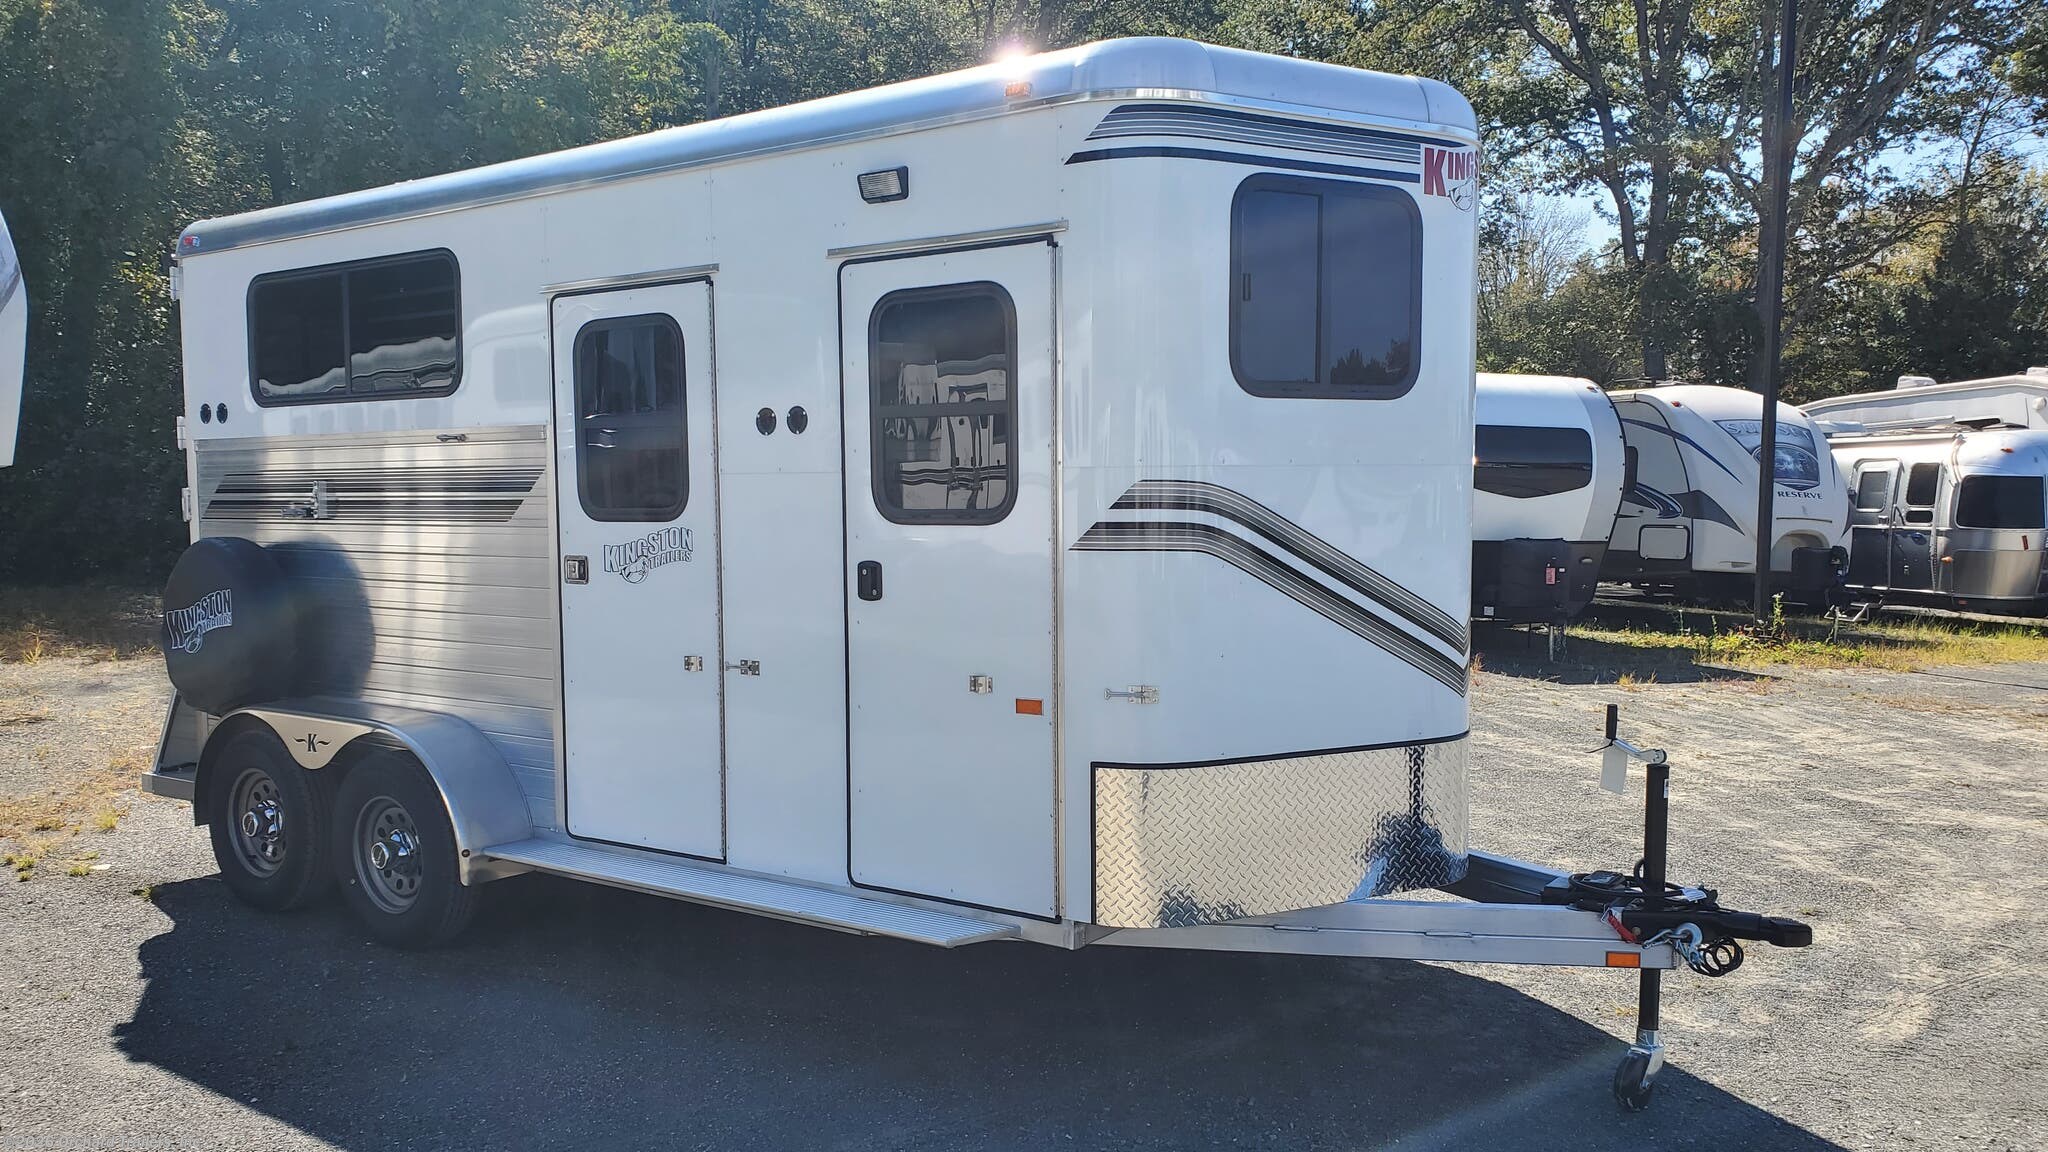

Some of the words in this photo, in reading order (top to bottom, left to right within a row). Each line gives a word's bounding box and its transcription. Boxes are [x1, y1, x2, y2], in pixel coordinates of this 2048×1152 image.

[1727, 423, 1811, 440] SUSET
[1777, 490, 1823, 499] RESERVE
[603, 527, 694, 573] KINGSTON
[649, 549, 692, 570] TRAILERS
[166, 589, 232, 649] KINGSTON
